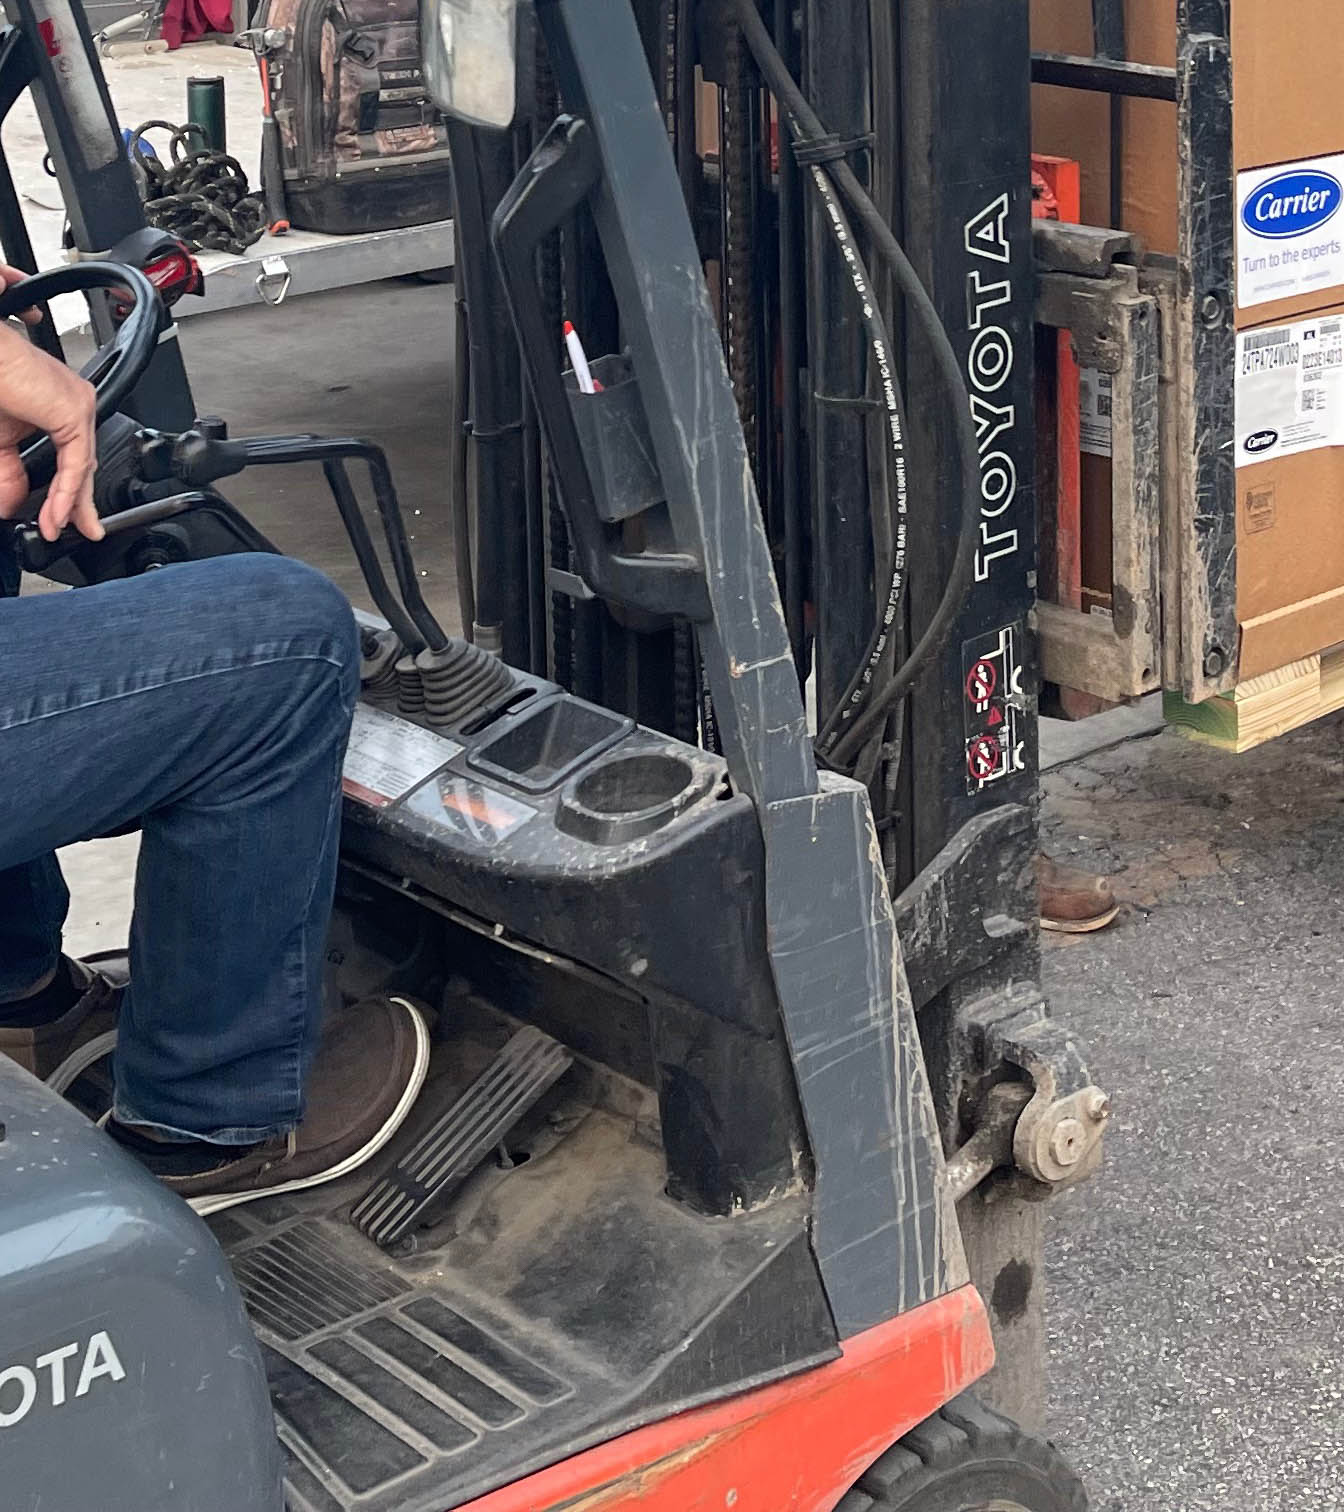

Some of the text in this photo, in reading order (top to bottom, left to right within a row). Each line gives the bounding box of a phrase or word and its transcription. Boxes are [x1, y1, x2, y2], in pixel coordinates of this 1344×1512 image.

[1255, 186, 1331, 222] Carrier
[1243, 239, 1341, 273] Turn to the experts
[965, 192, 1019, 582] TOYOTA
